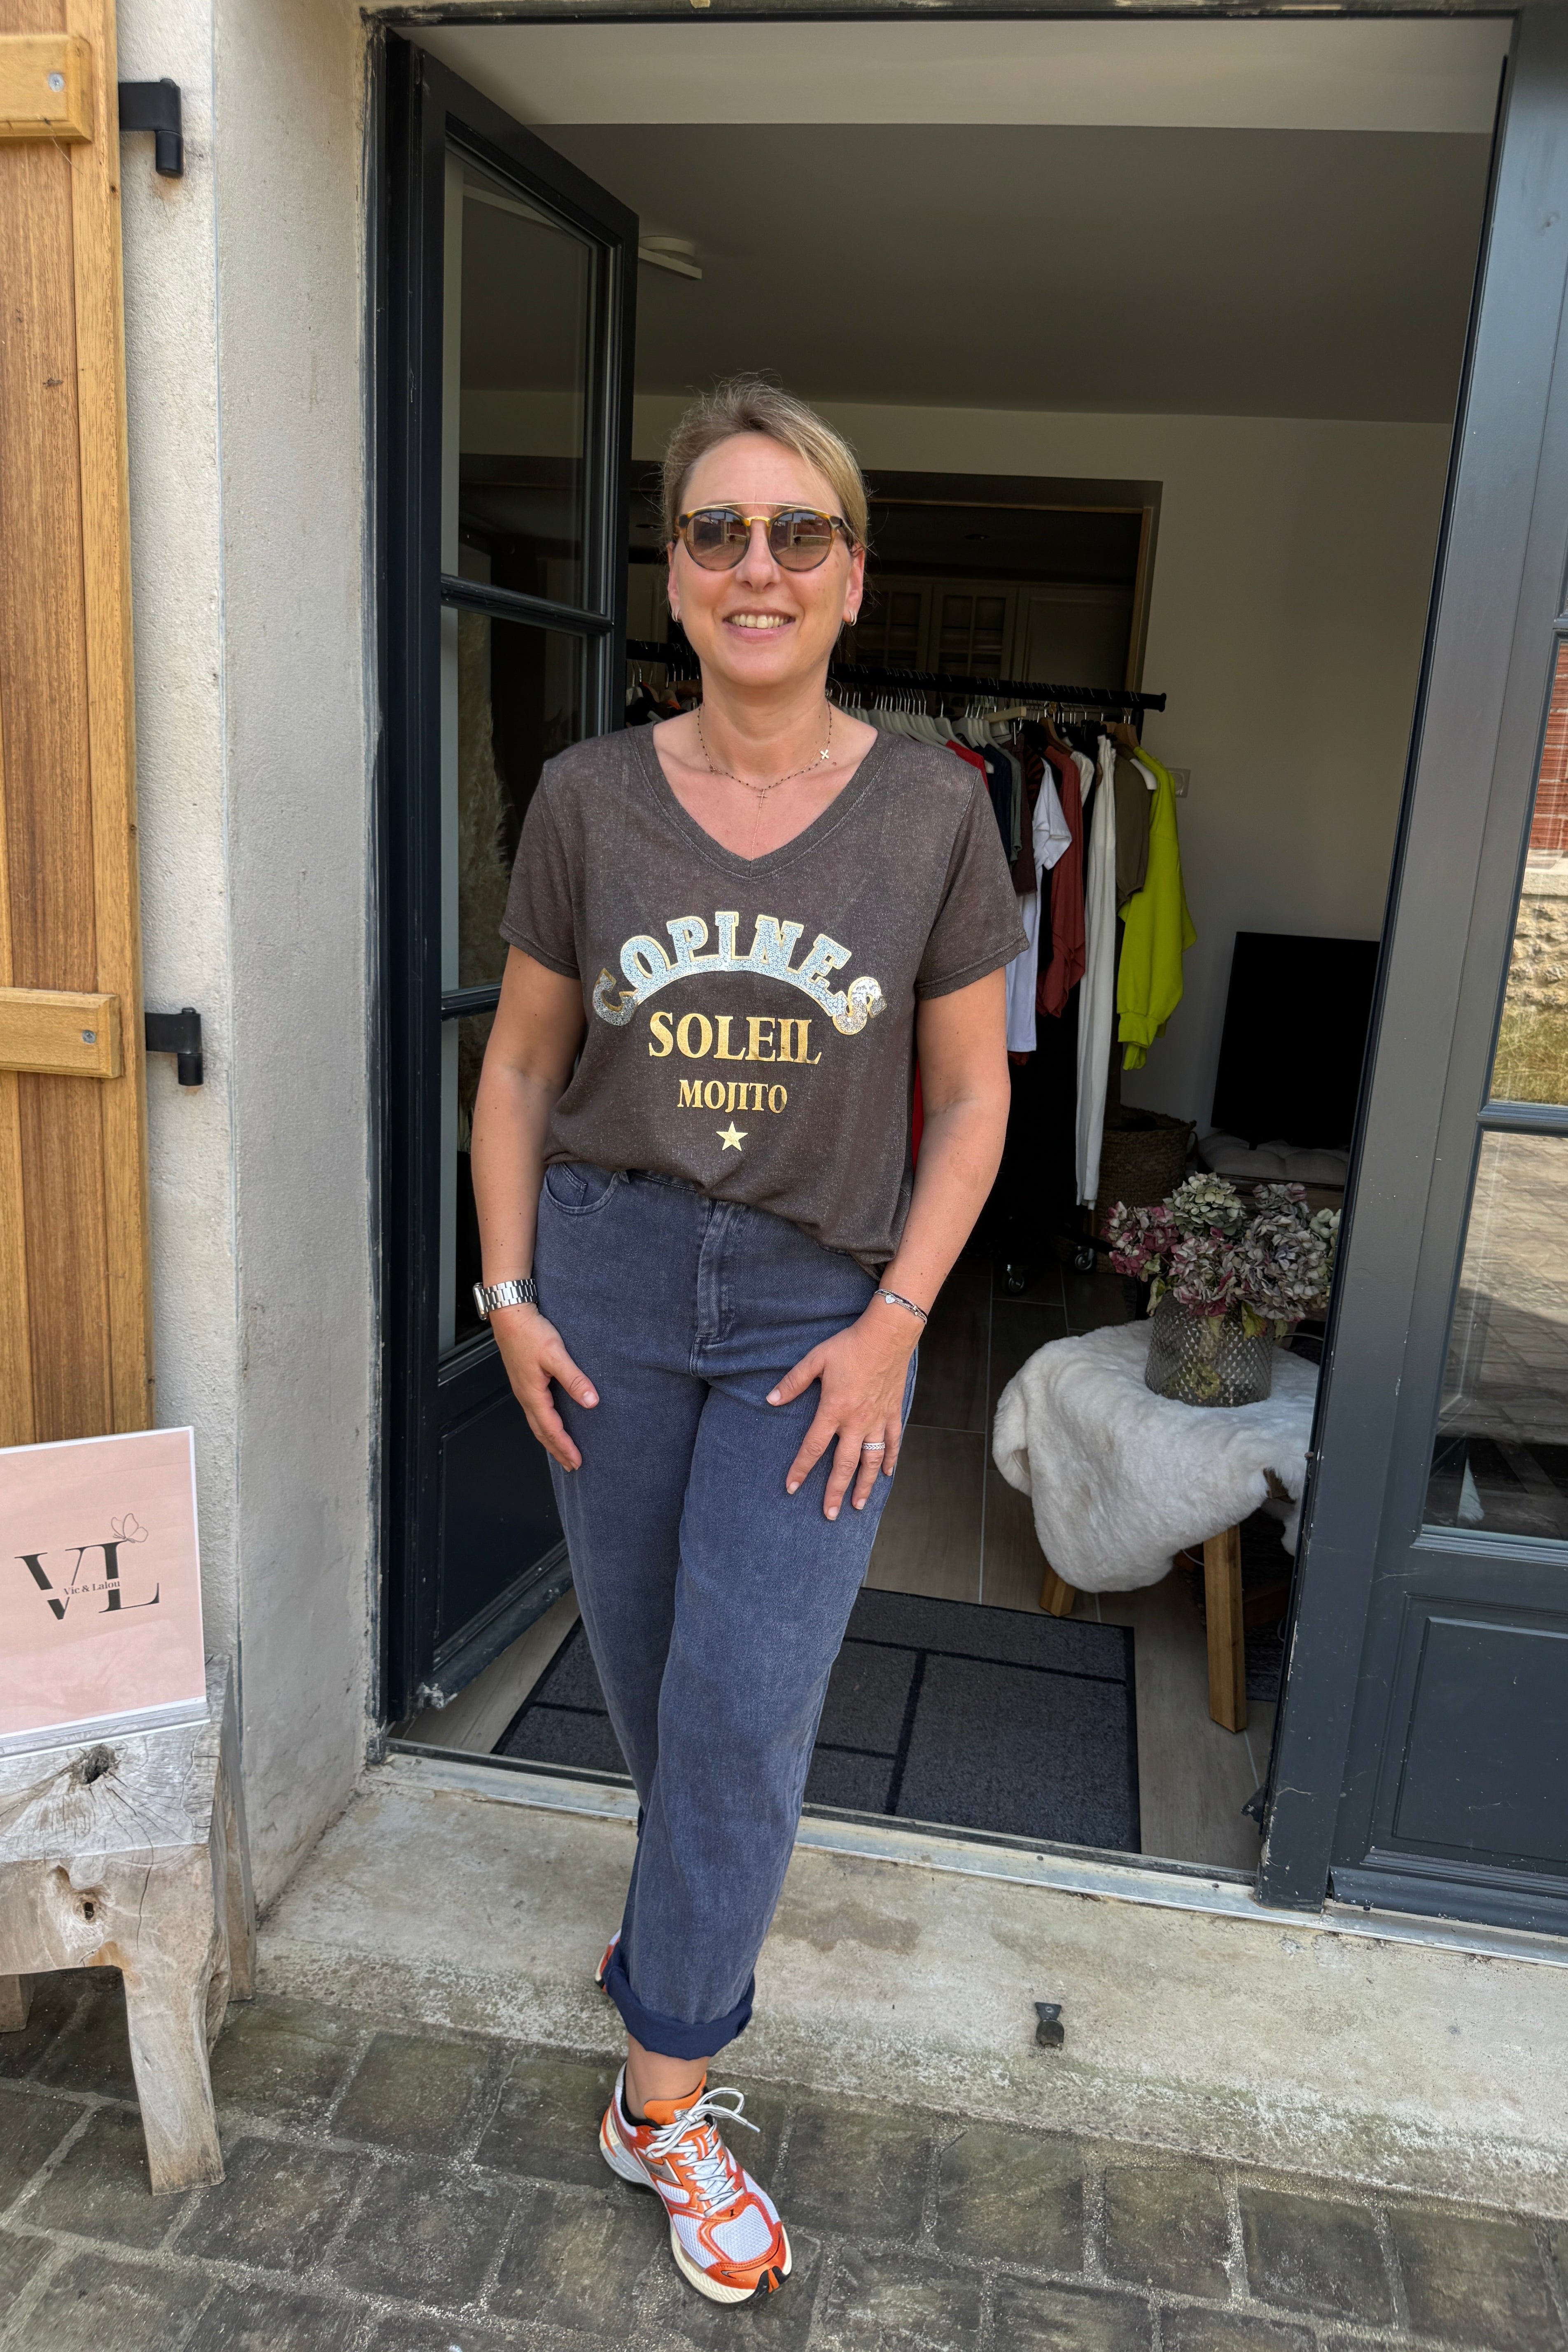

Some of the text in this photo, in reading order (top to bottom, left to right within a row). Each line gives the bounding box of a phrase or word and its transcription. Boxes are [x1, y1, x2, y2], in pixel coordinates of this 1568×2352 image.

[592, 911, 887, 1036] COPINES
[649, 1012, 822, 1064] SOLEIL
[677, 1080, 788, 1114] MOJITO
[14, 1540, 159, 1620] VL
[92, 1581, 120, 1591] Lalou
